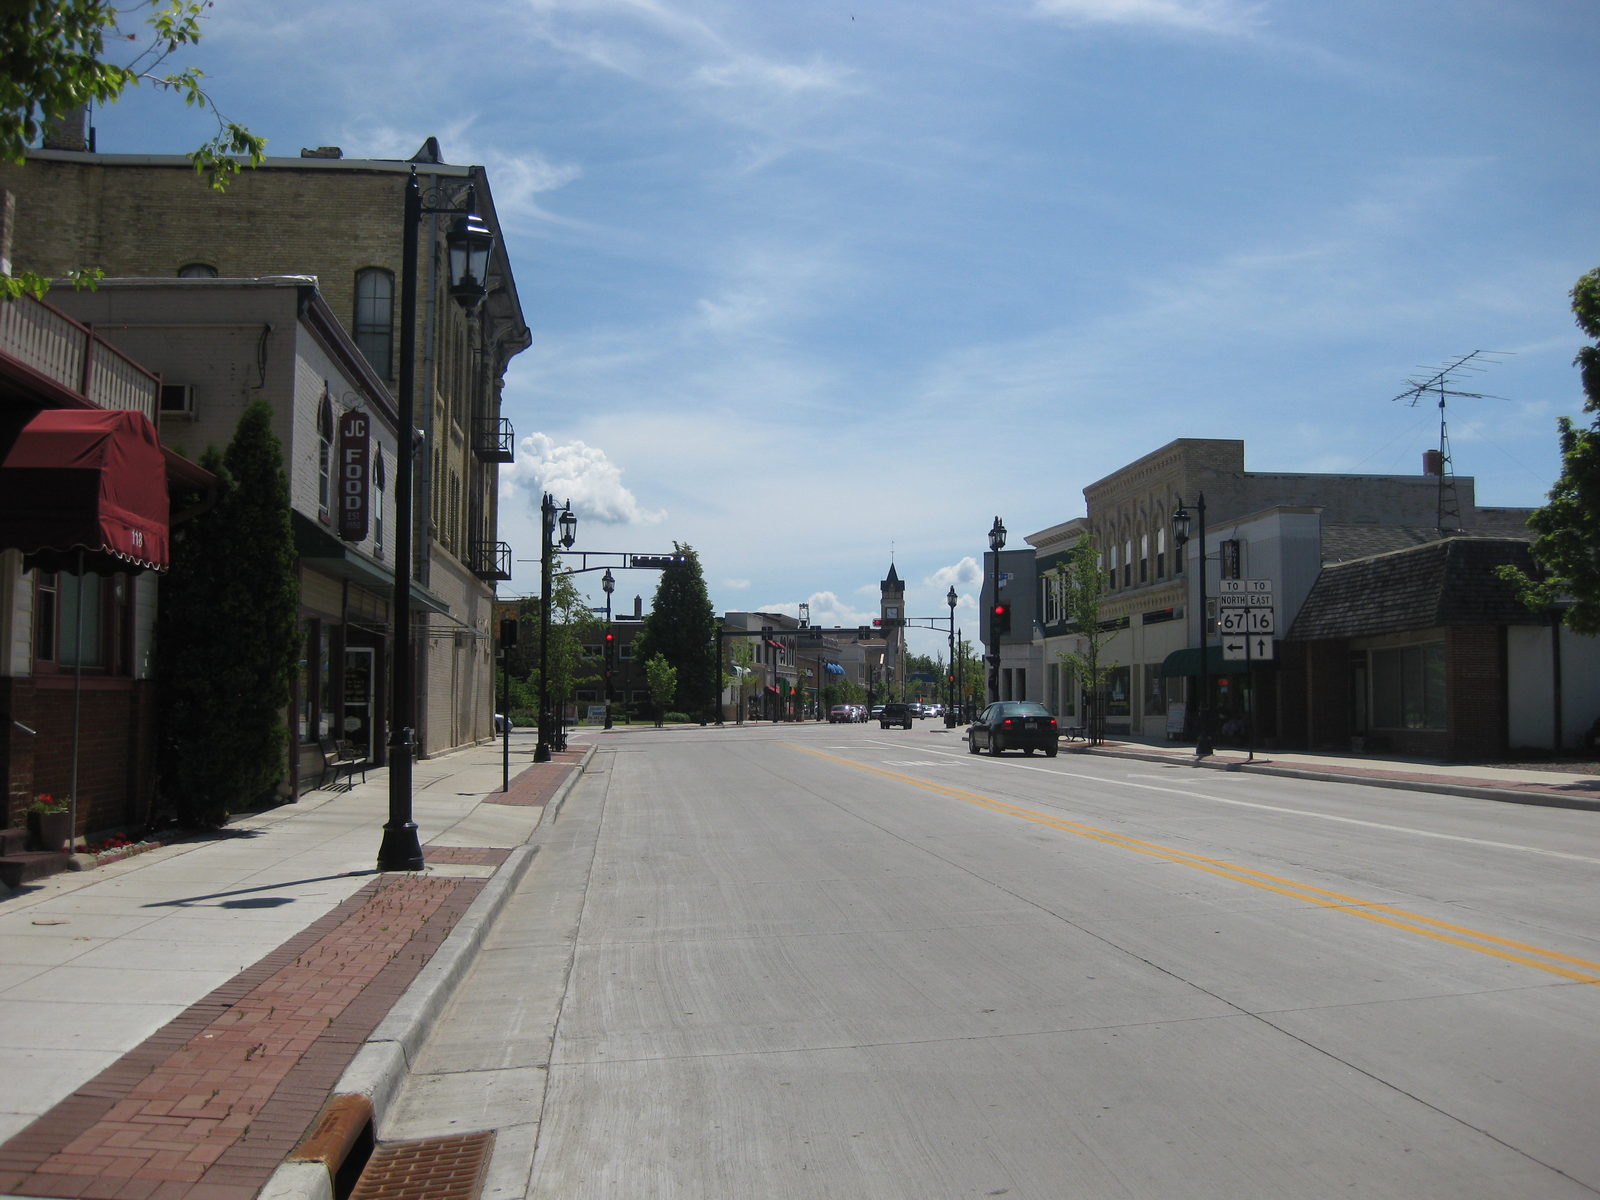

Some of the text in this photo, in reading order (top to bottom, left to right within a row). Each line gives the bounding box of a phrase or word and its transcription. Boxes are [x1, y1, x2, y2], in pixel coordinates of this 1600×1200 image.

[345, 420, 365, 437] JC
[345, 449, 363, 510] FOOD
[132, 528, 143, 548] 118
[1227, 582, 1239, 591] TO
[1254, 582, 1266, 591] TO
[1221, 596, 1245, 605] NORTH
[1250, 596, 1270, 605] EAST
[1224, 613, 1244, 629] 67
[1252, 613, 1270, 629] 16
